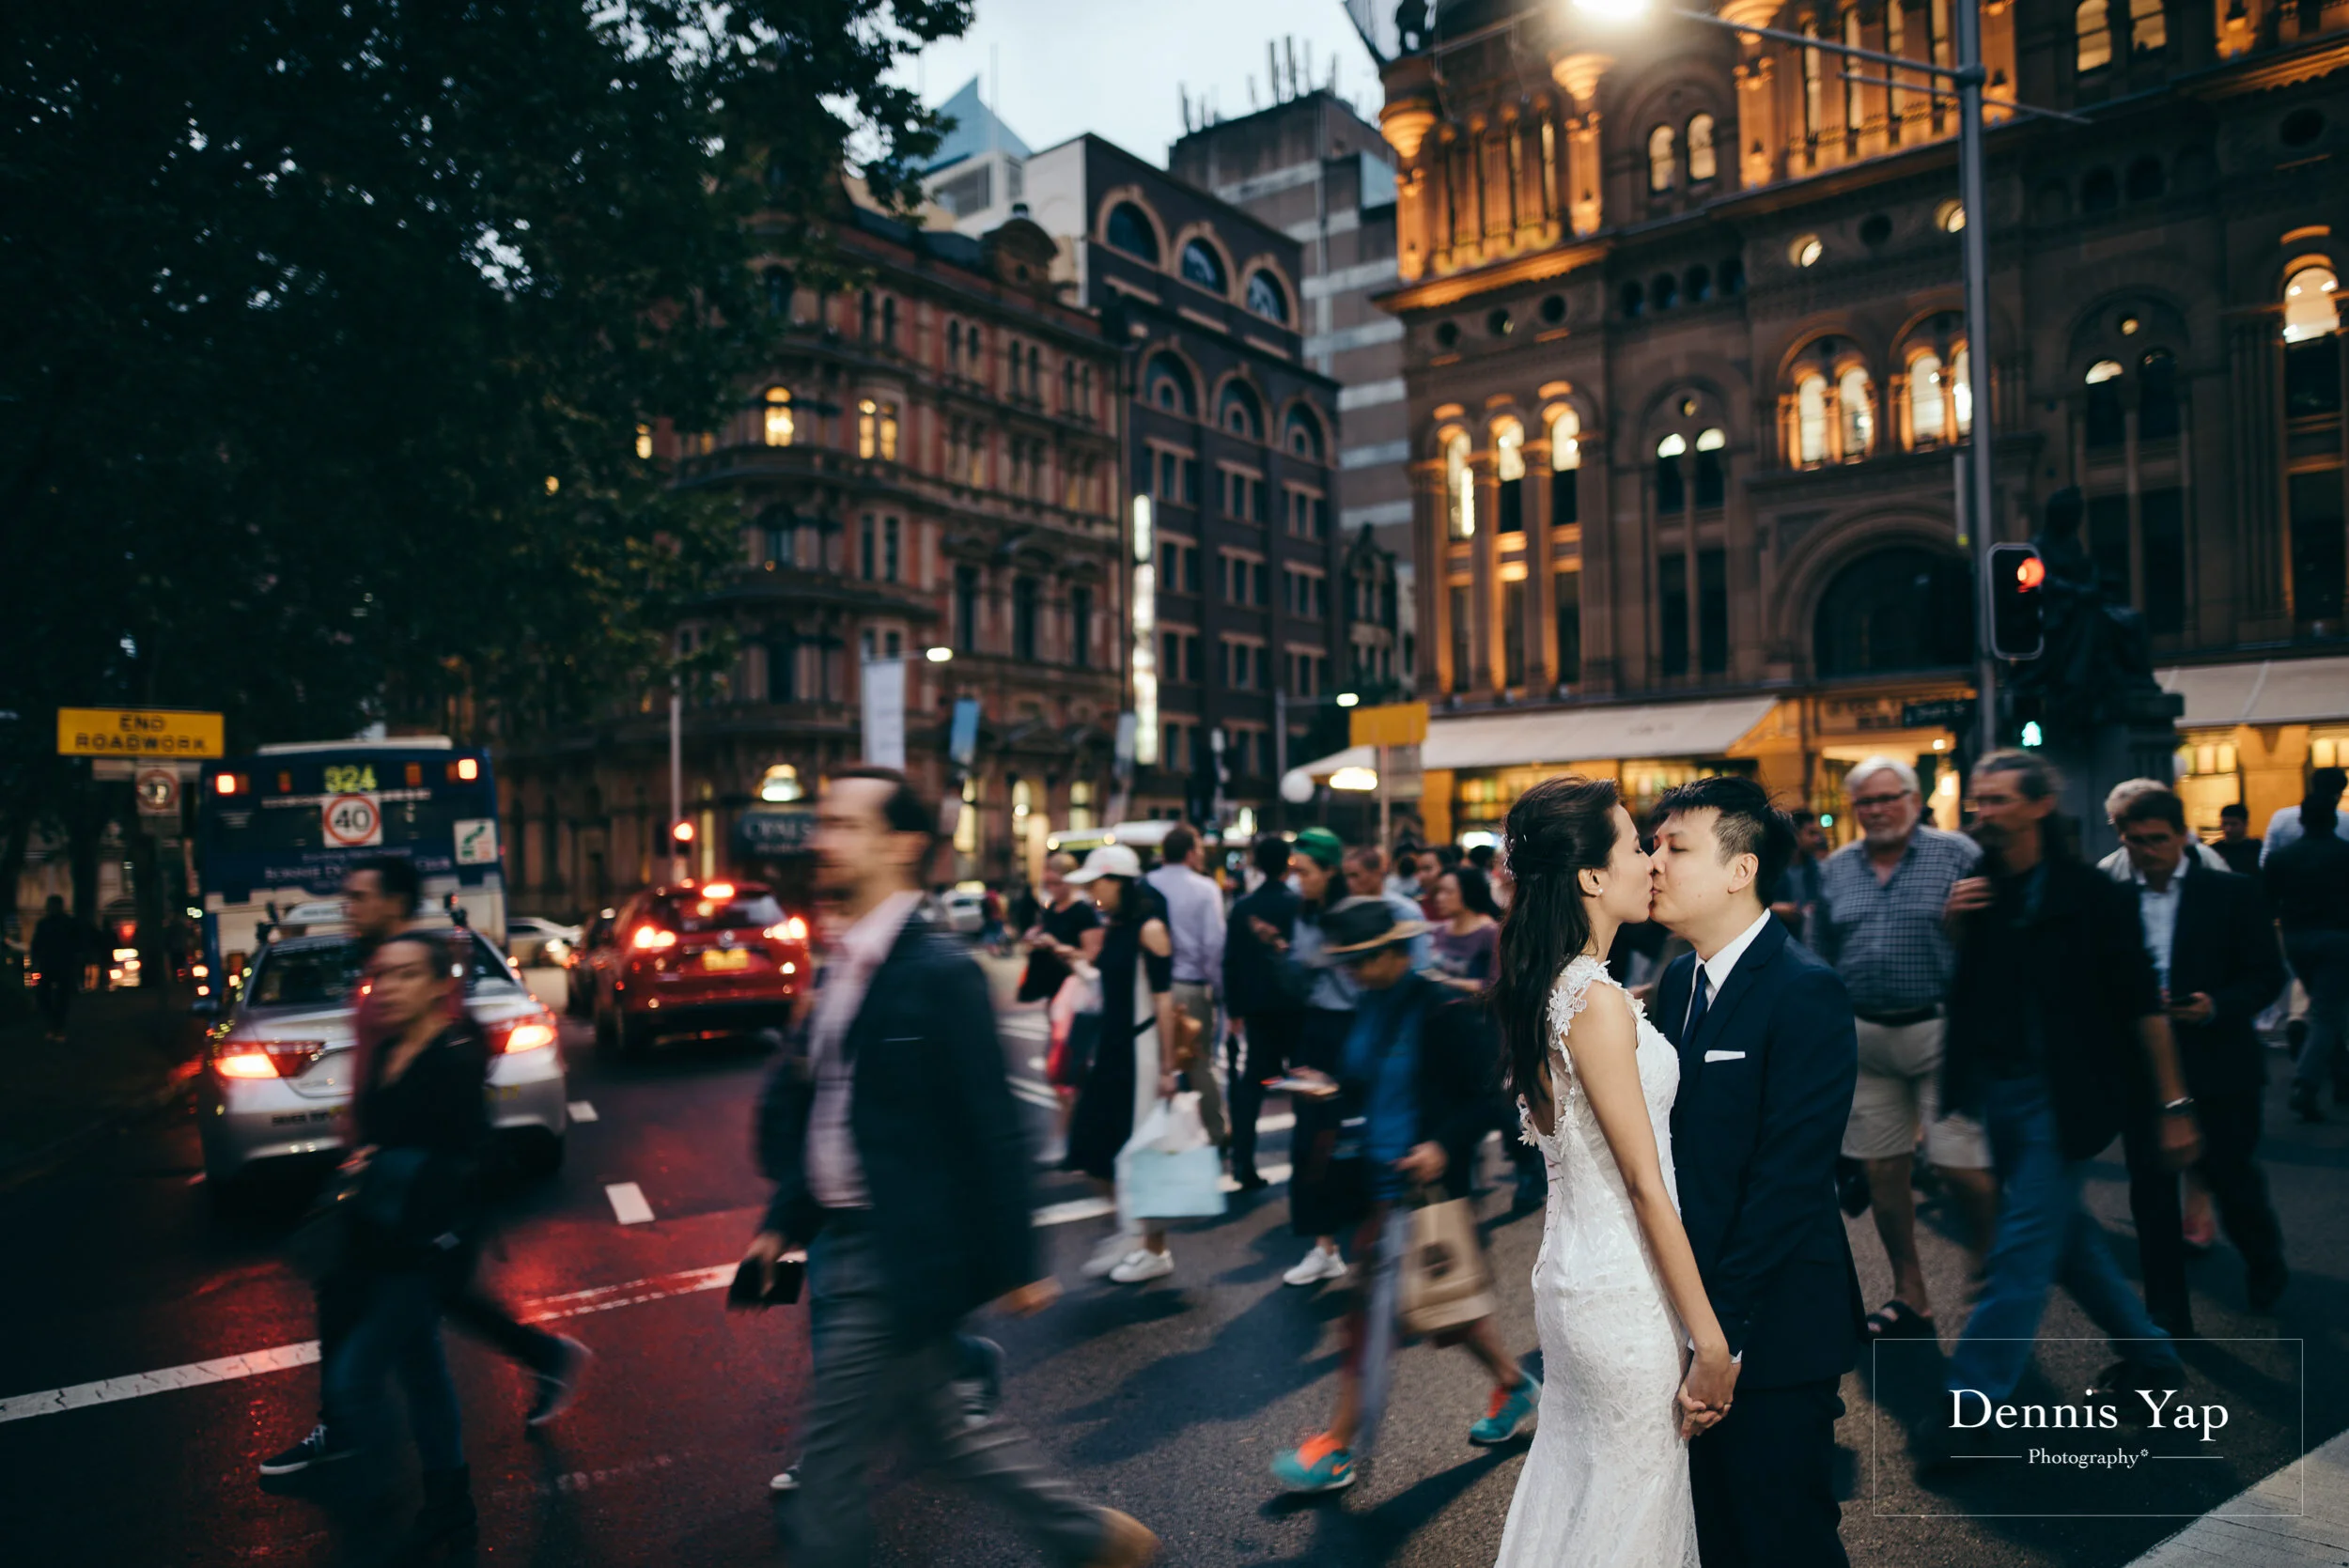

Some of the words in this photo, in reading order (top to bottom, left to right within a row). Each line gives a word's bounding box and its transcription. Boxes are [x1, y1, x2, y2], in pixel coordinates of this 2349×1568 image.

[119, 714, 166, 732] END
[75, 733, 206, 752] ROADWORK
[334, 807, 370, 831] 40
